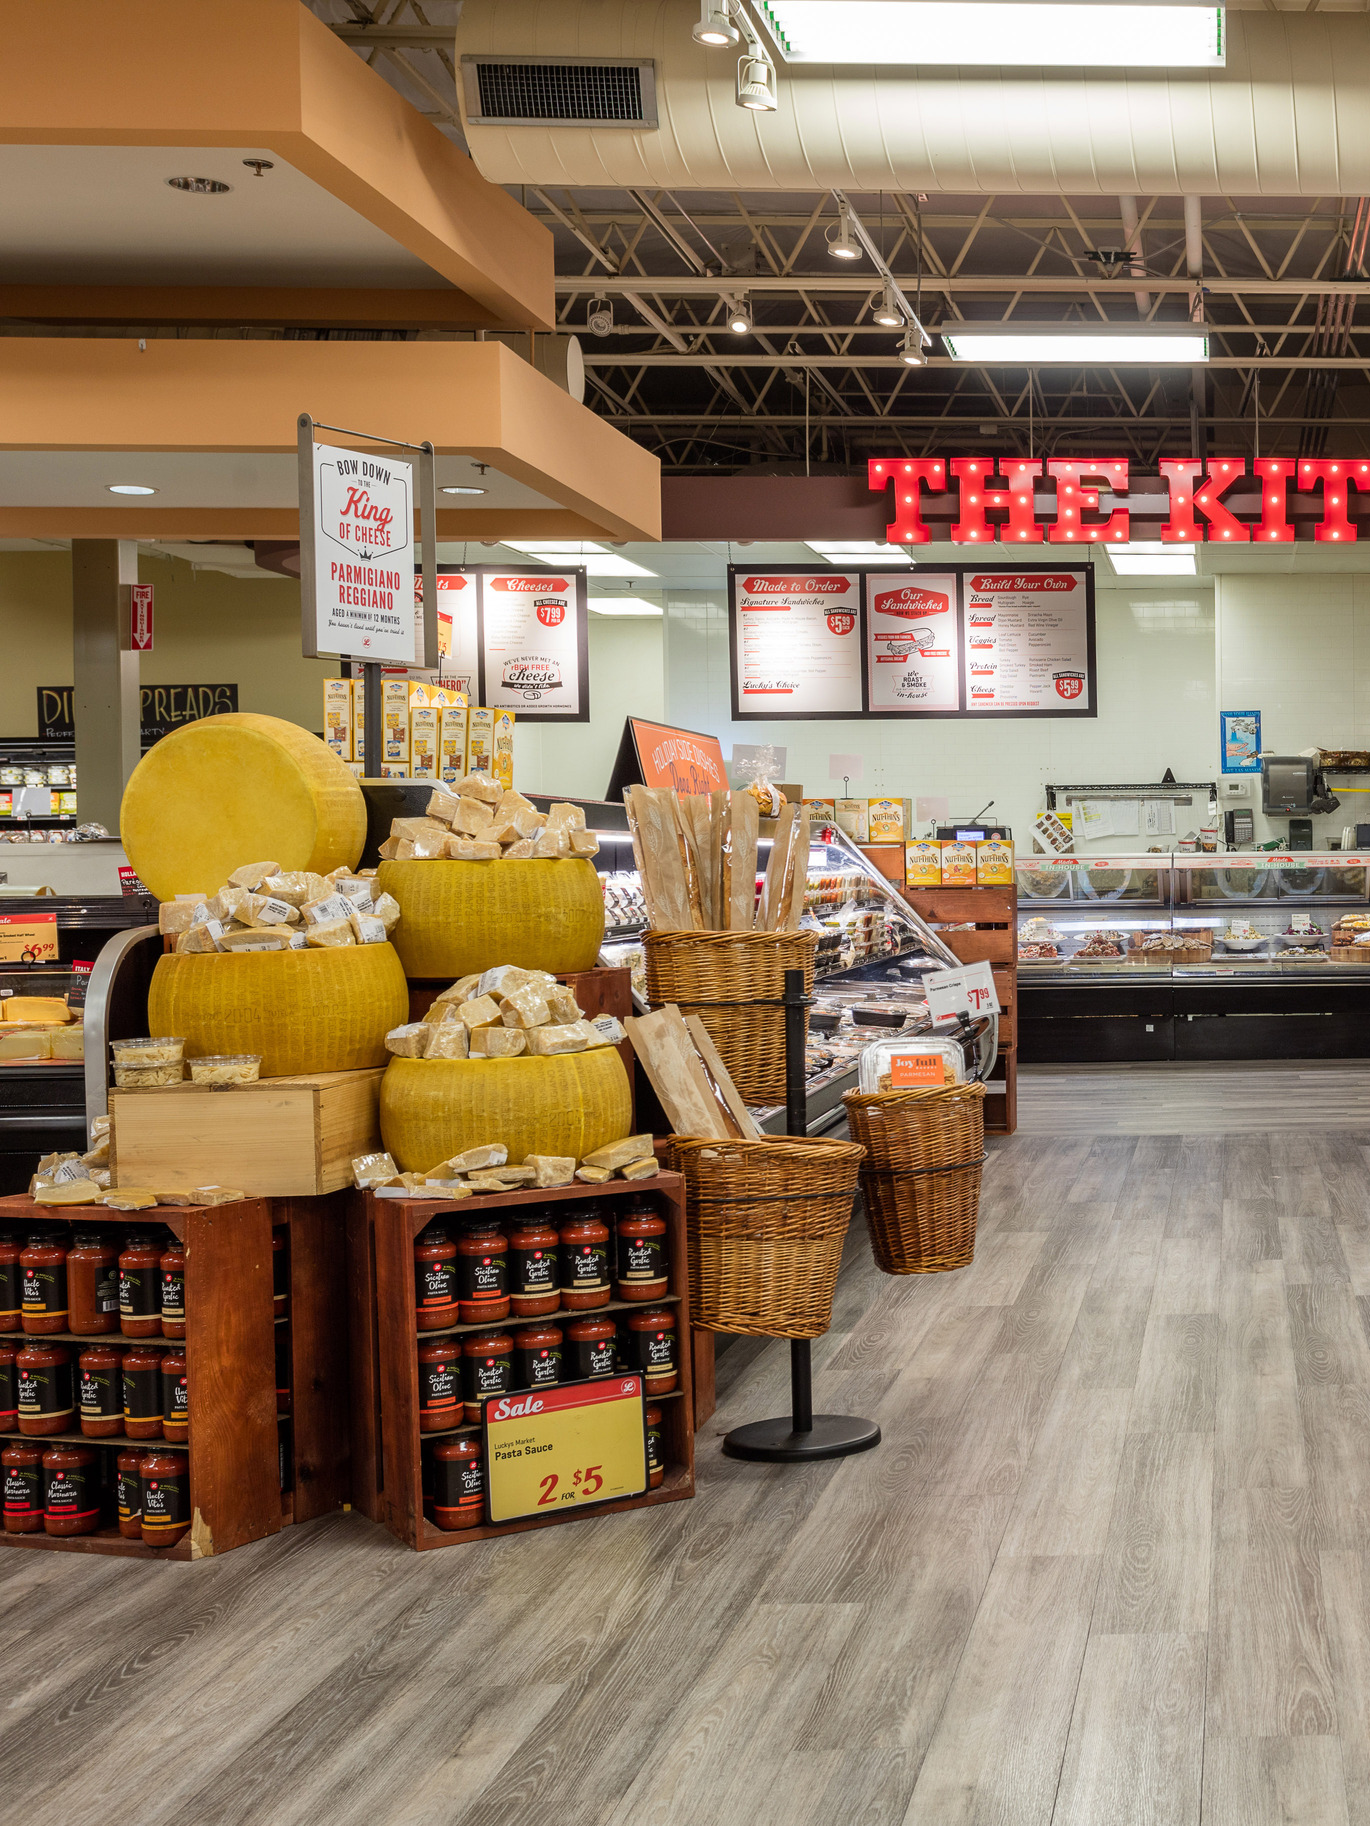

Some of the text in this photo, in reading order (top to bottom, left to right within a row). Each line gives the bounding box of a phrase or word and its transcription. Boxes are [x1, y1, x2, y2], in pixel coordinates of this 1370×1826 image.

[337, 460, 391, 486] BOW DOWN
[869, 457, 1129, 544] THE
[340, 486, 393, 532] King
[340, 522, 391, 547] OF CHEESE
[331, 562, 400, 590] PARMIGIANO
[507, 579, 553, 591] Cheeses
[753, 579, 840, 591] Made to Order
[980, 578, 1067, 590] Build Your Own
[136, 591, 150, 599] FIRE
[339, 585, 393, 610] REGGIANO
[901, 589, 923, 600] Our
[970, 594, 994, 602] Bread
[740, 597, 824, 606] Signature Sandwiches
[881, 599, 943, 610] Sandwiches
[332, 608, 344, 618] AGED
[373, 613, 379, 623] 12
[380, 614, 400, 625] MONTHS
[968, 613, 996, 622] Spread
[969, 635, 996, 645] Veggies
[970, 661, 997, 669] Protein
[509, 668, 555, 681] cheese
[971, 684, 996, 693] Cheese
[140, 686, 233, 722] PREADS
[652, 739, 720, 783] HOLIDAY SIDE DISHES
[669, 762, 691, 794] Done
[895, 1058, 937, 1068] Joyfull
[429, 1281, 447, 1290] Olive
[494, 1396, 544, 1420] Sale
[494, 1437, 536, 1450] Luckys Market
[495, 1443, 553, 1461] Pasta Sauce
[6, 1478, 26, 1487] Classic
[537, 1465, 603, 1506] 2 FOR $5
